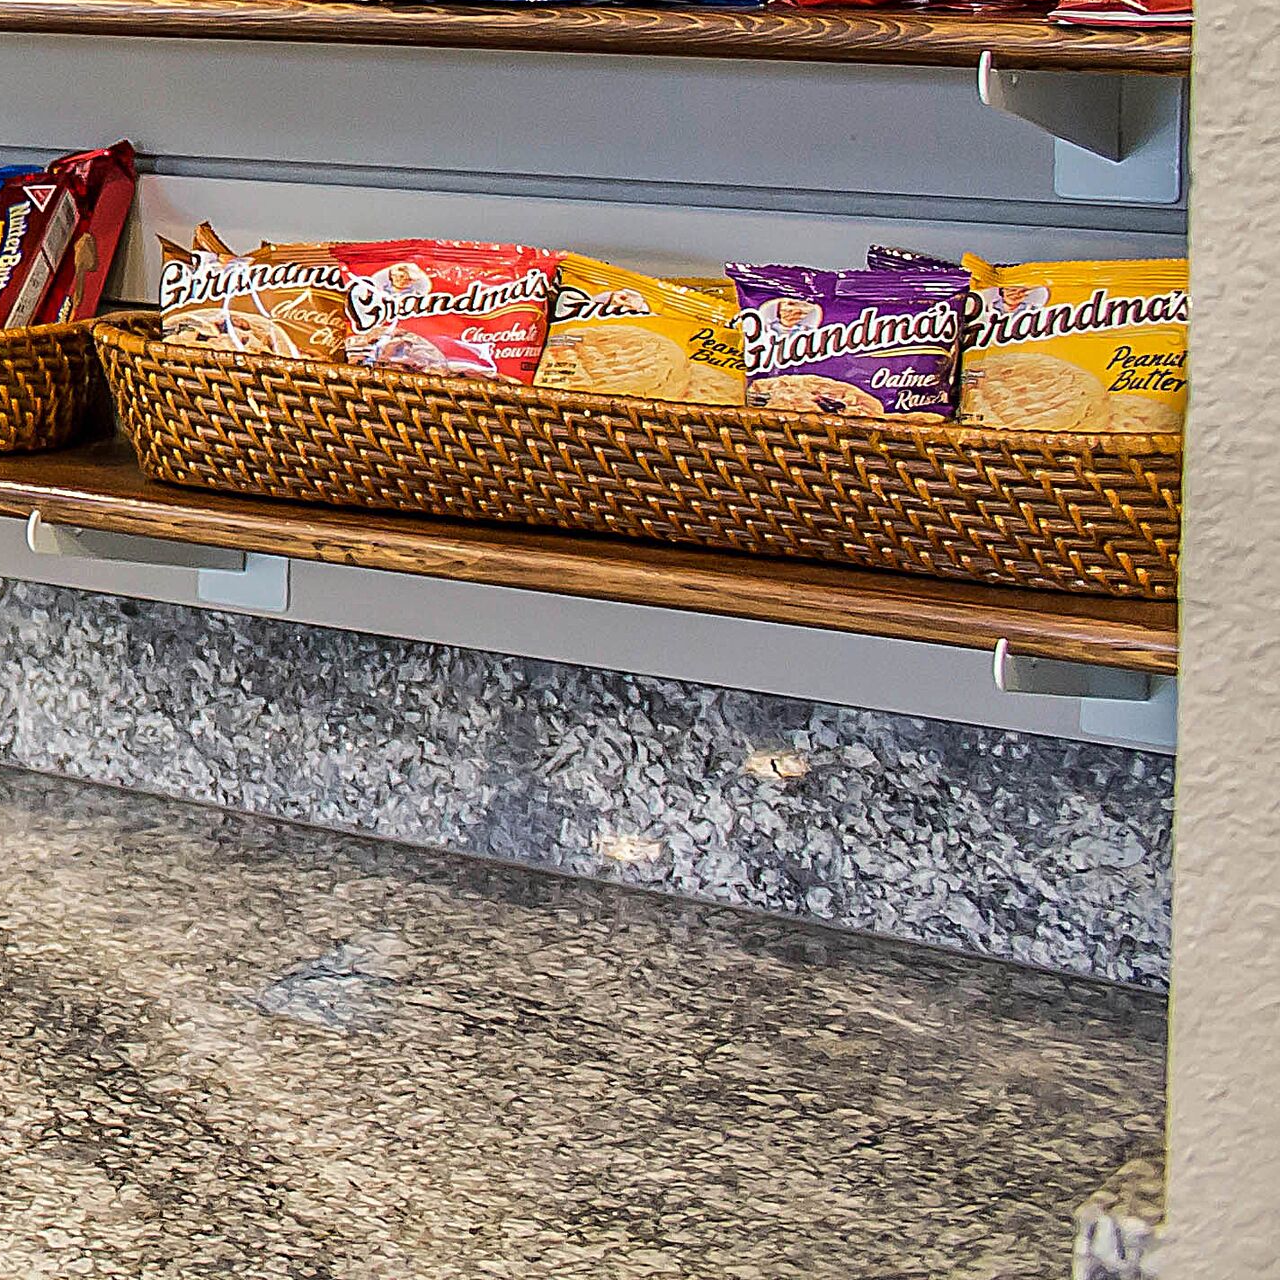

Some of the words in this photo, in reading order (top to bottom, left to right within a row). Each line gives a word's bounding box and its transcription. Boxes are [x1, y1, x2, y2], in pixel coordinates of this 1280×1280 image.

[2, 200, 32, 254] Nutter
[161, 255, 344, 311] Grandma
[348, 268, 553, 333] Grandma's
[271, 297, 343, 328] Chocola
[742, 302, 957, 371] Grandma's
[960, 288, 1188, 350] Grandma's
[689, 348, 746, 371] Butte
[871, 366, 939, 388] Oatme
[1111, 371, 1188, 393] Butter
